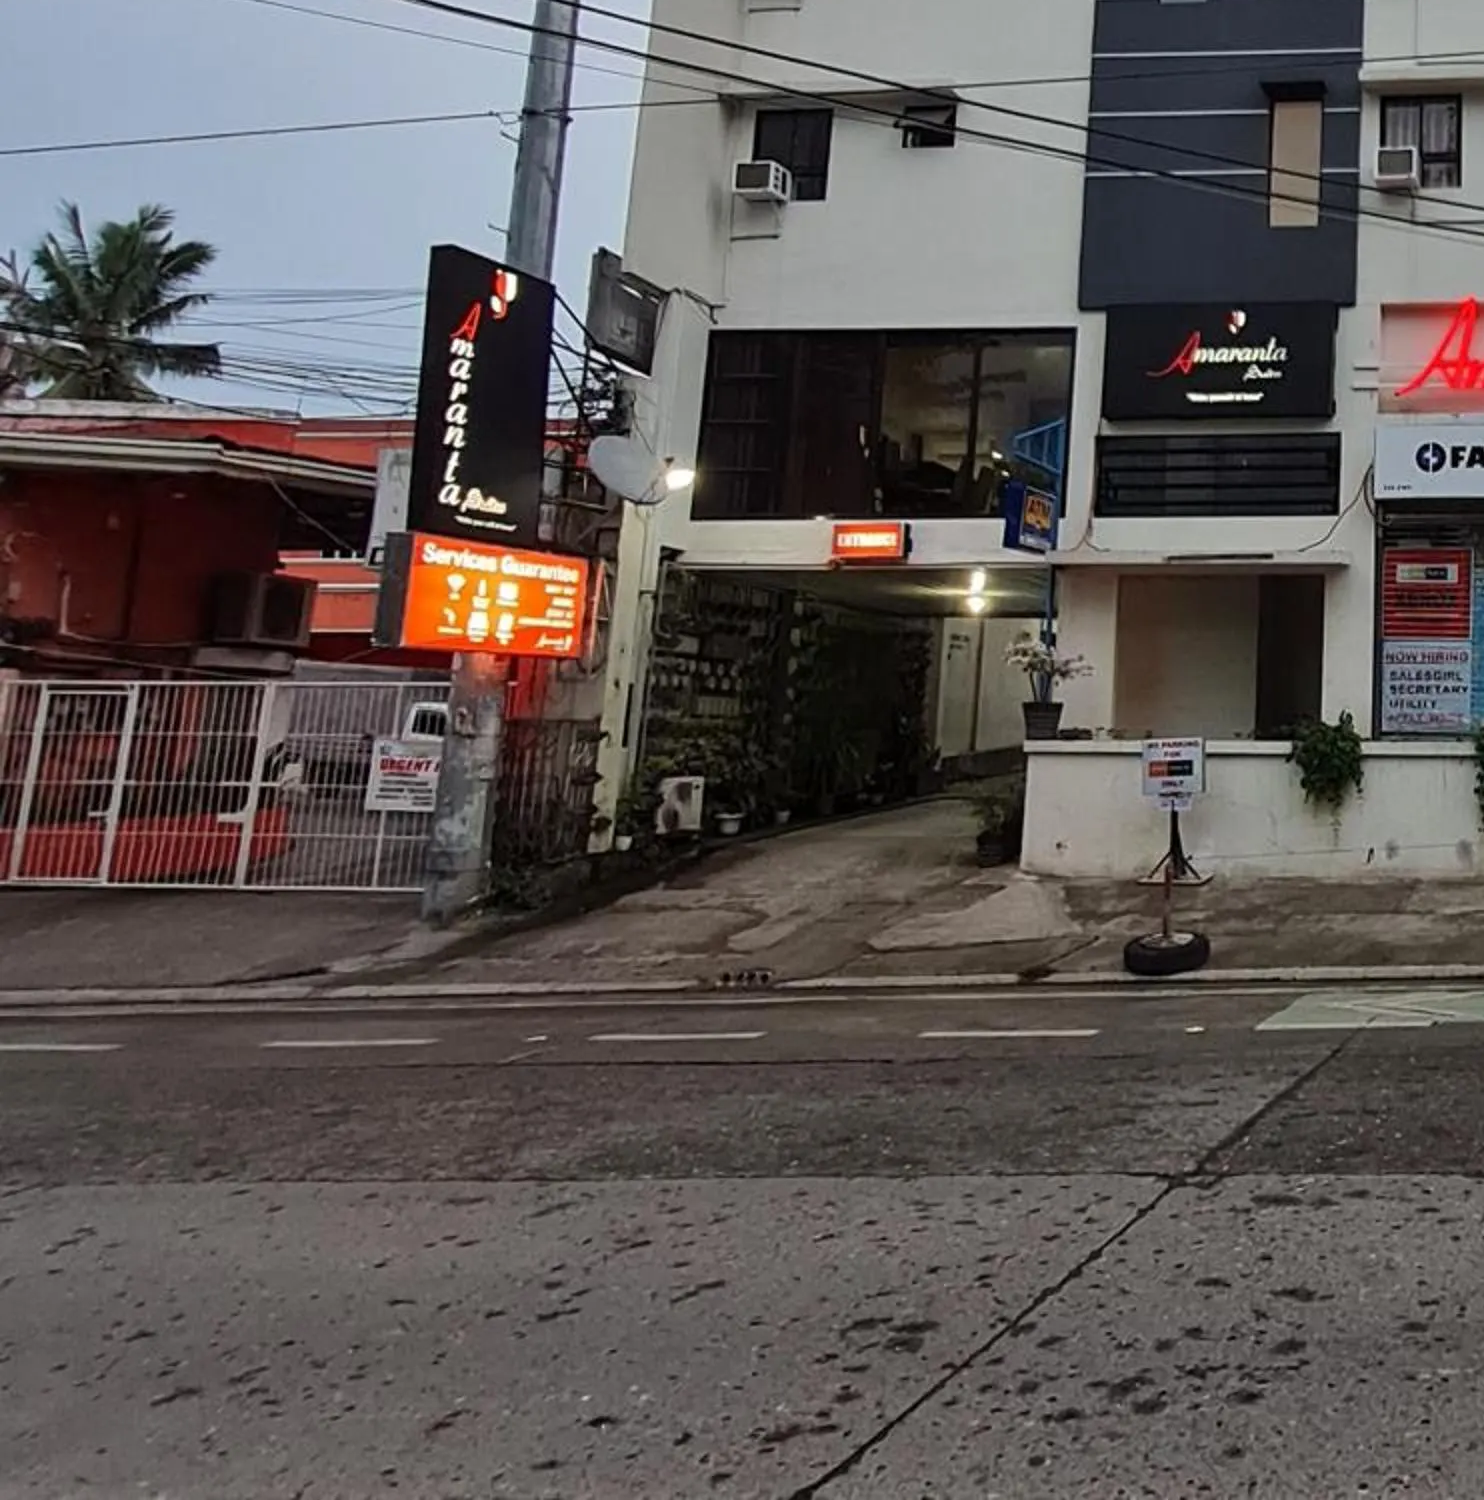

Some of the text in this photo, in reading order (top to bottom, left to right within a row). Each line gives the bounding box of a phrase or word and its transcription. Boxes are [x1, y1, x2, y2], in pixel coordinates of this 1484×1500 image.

[1145, 331, 1288, 377] Amaranta
[438, 301, 482, 506] Amaranta
[422, 542, 580, 584] Services Guarantee
[1386, 652, 1418, 663] NOW
[1389, 684, 1469, 695] SECRETARY
[380, 758, 433, 773] URGENT
